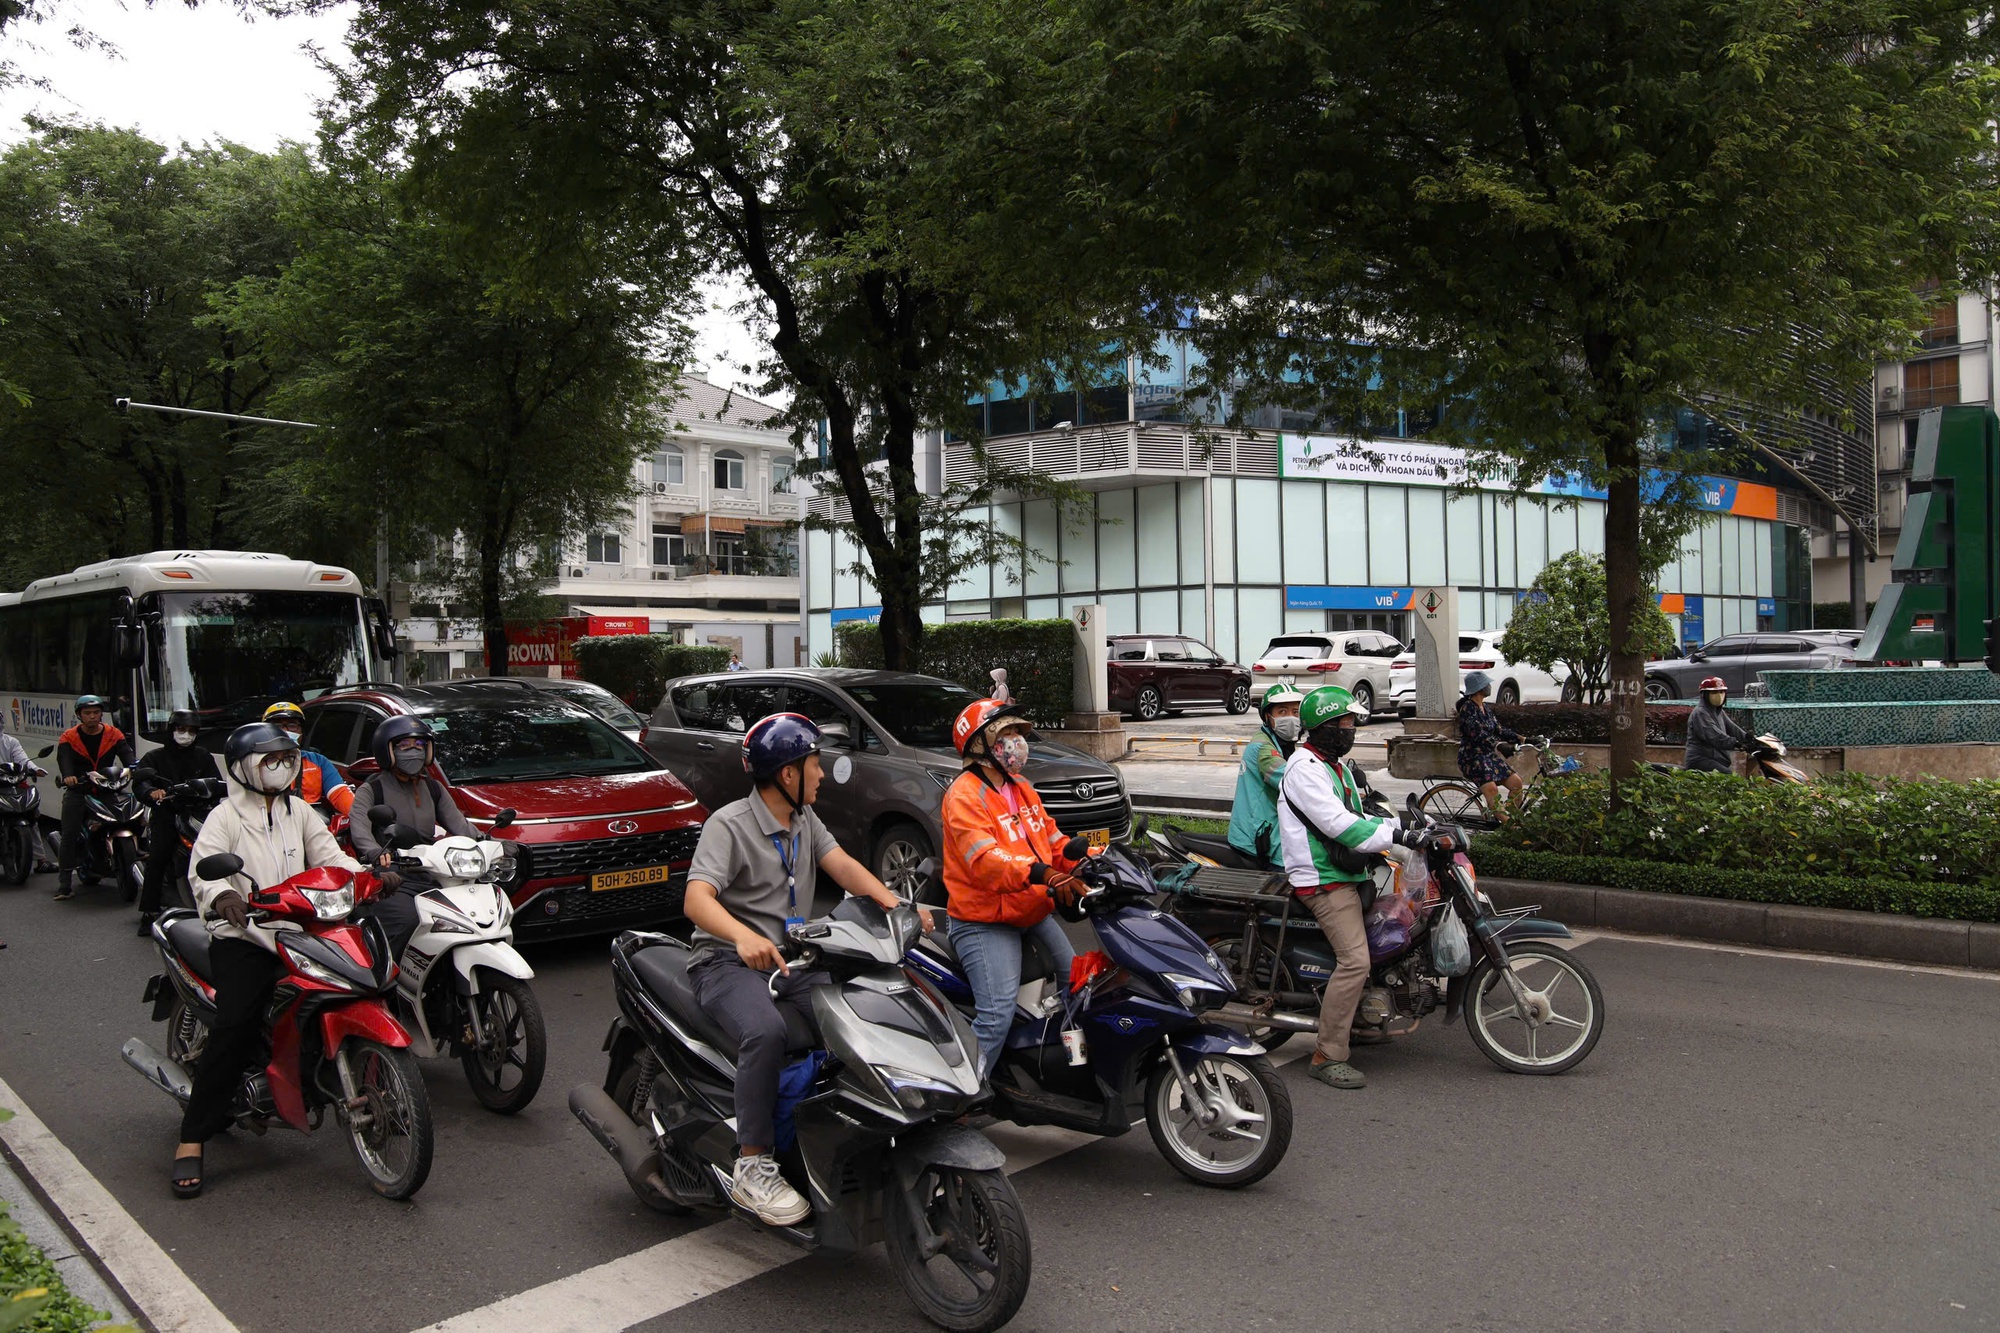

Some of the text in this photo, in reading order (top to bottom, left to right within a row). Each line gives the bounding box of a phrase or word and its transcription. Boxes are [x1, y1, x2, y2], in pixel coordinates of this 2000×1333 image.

[1388, 453, 1398, 461] TY
[1438, 457, 1465, 467] KHOAN
[1336, 461, 1347, 470] VÀ
[1350, 463, 1370, 473] DỊCH
[1386, 466, 1415, 475] KHOAN
[1704, 491, 1721, 506] VIB
[1375, 596, 1393, 606] VIB
[508, 643, 555, 662] ROWN
[21, 699, 64, 729] Vietravel
[1315, 701, 1339, 716] Grab
[401, 965, 420, 981] YAMAHA
